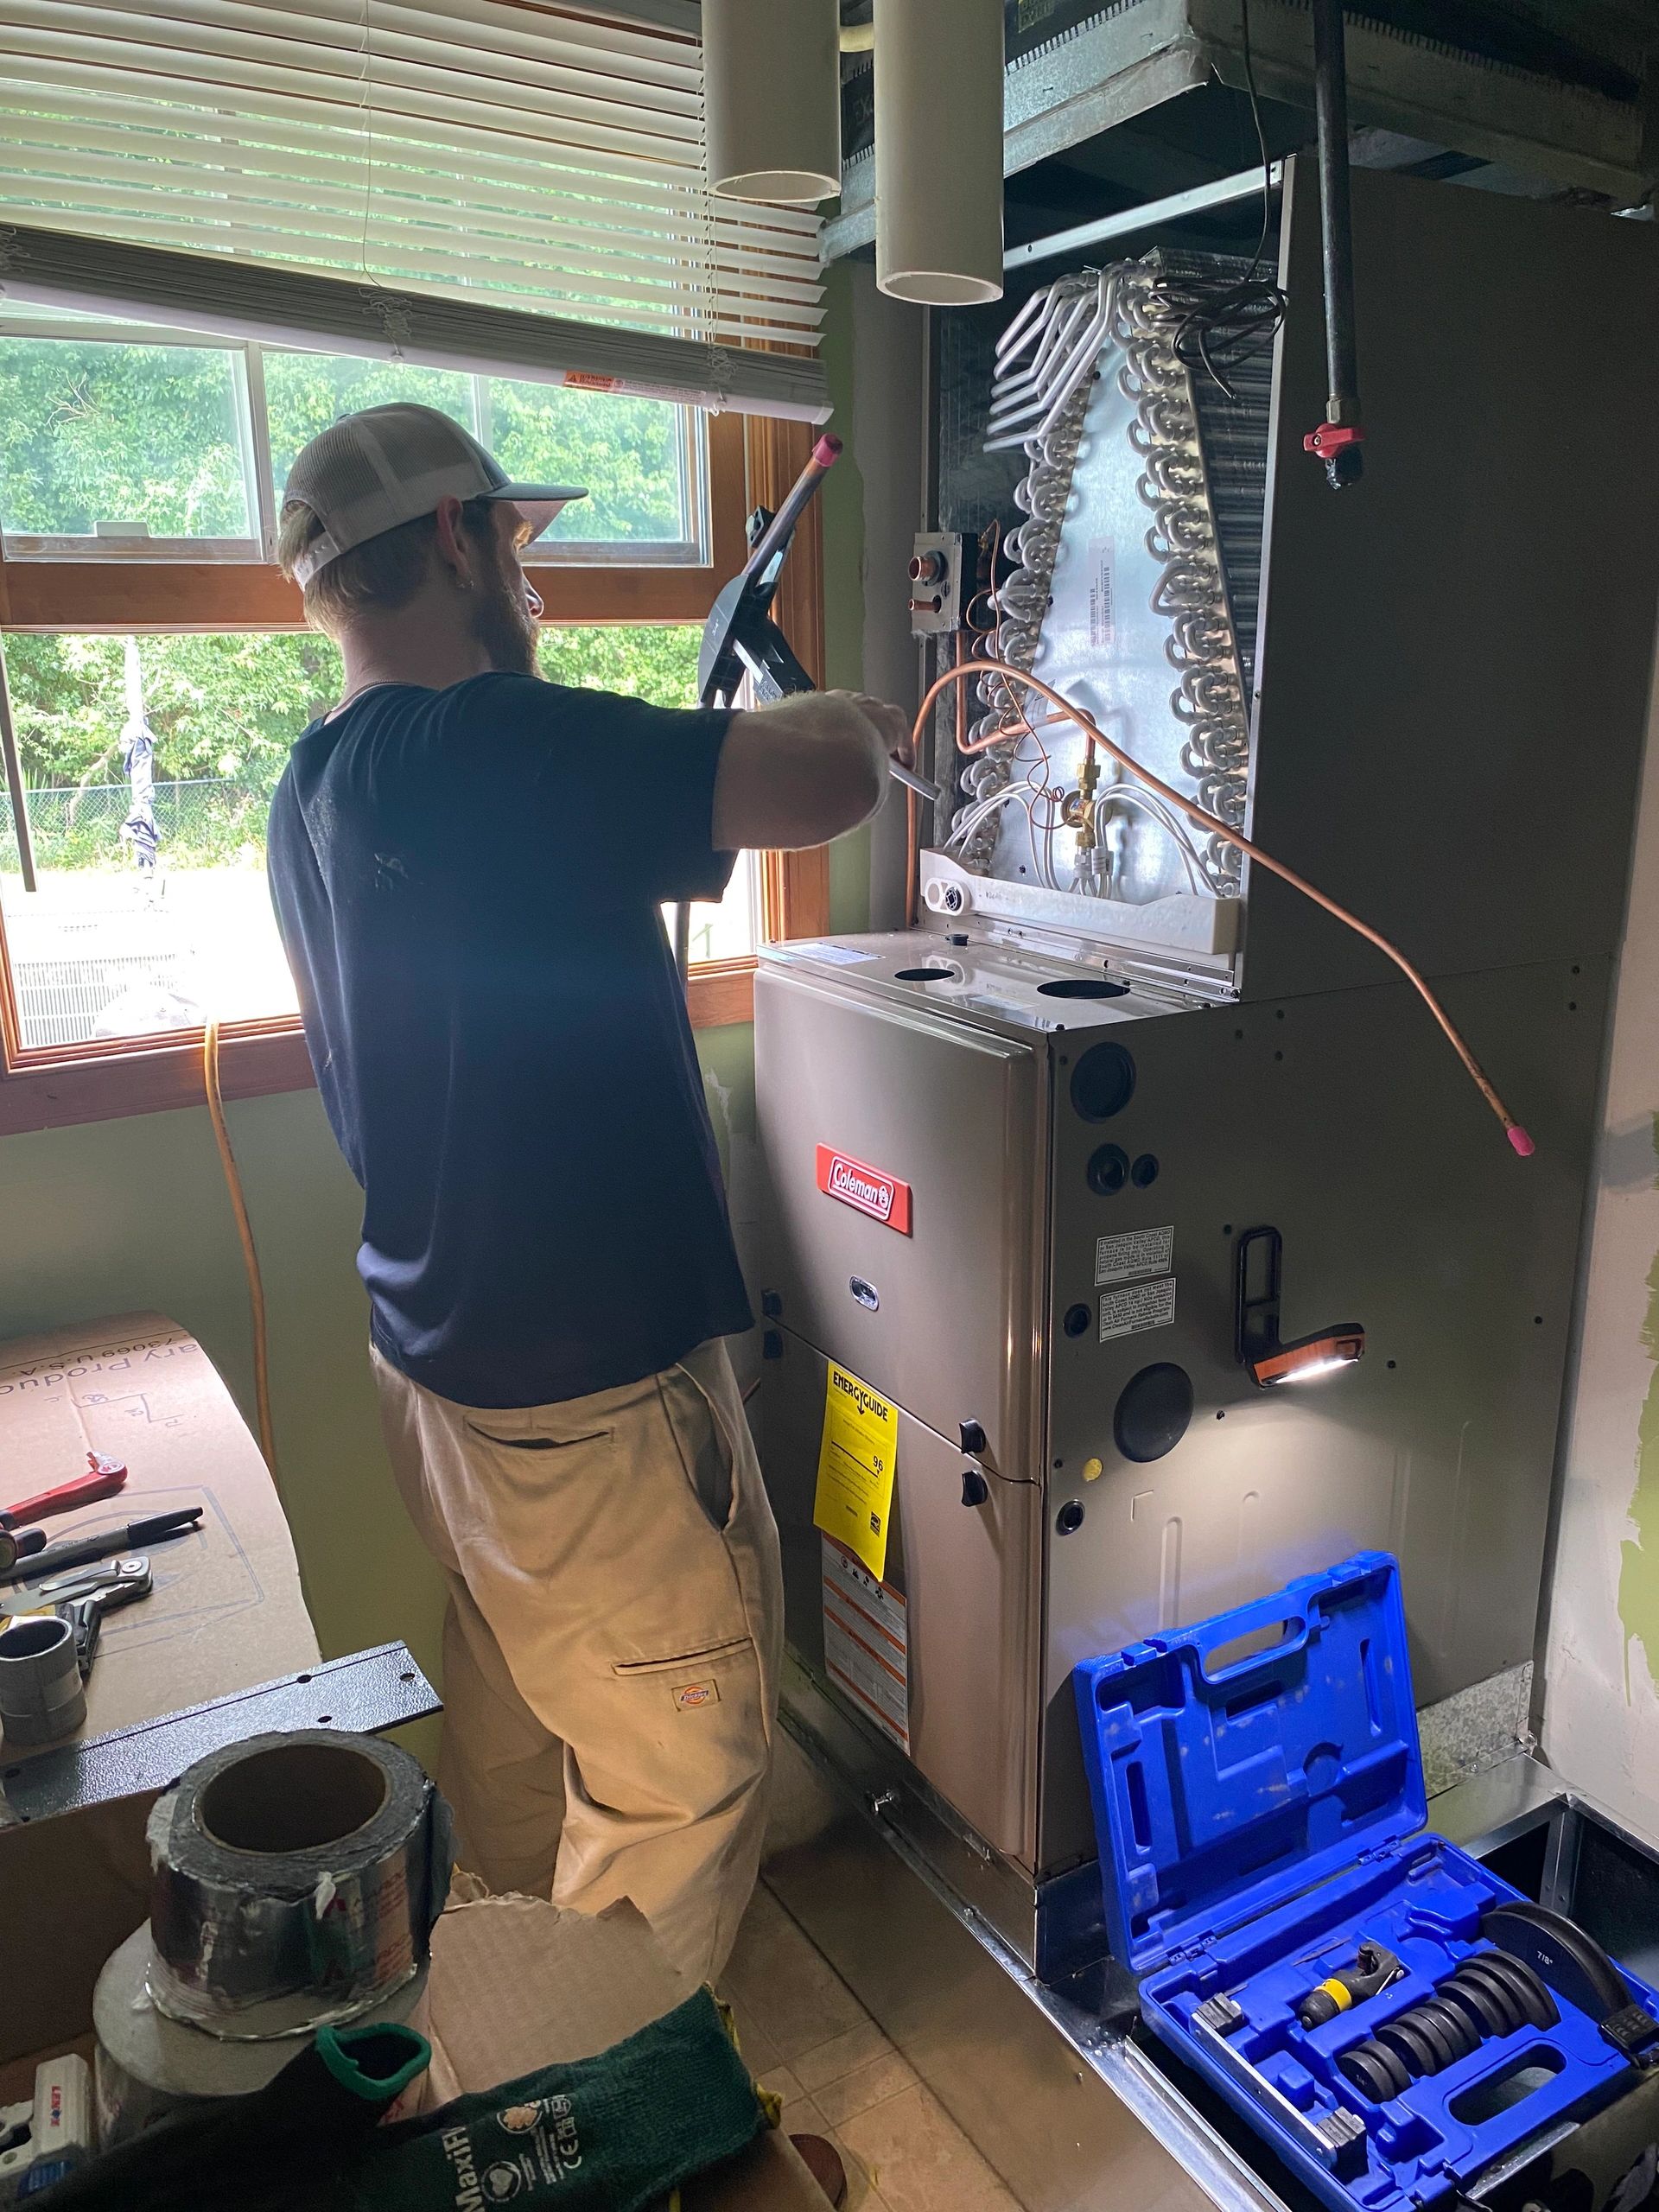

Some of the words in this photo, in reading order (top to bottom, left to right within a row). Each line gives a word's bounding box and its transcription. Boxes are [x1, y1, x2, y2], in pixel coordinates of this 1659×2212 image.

[833, 1162, 878, 1205] Coleman
[101, 1338, 177, 1358] 73069
[833, 1370, 888, 1423] ENERGYGUIDE
[873, 1454, 884, 1471] 96
